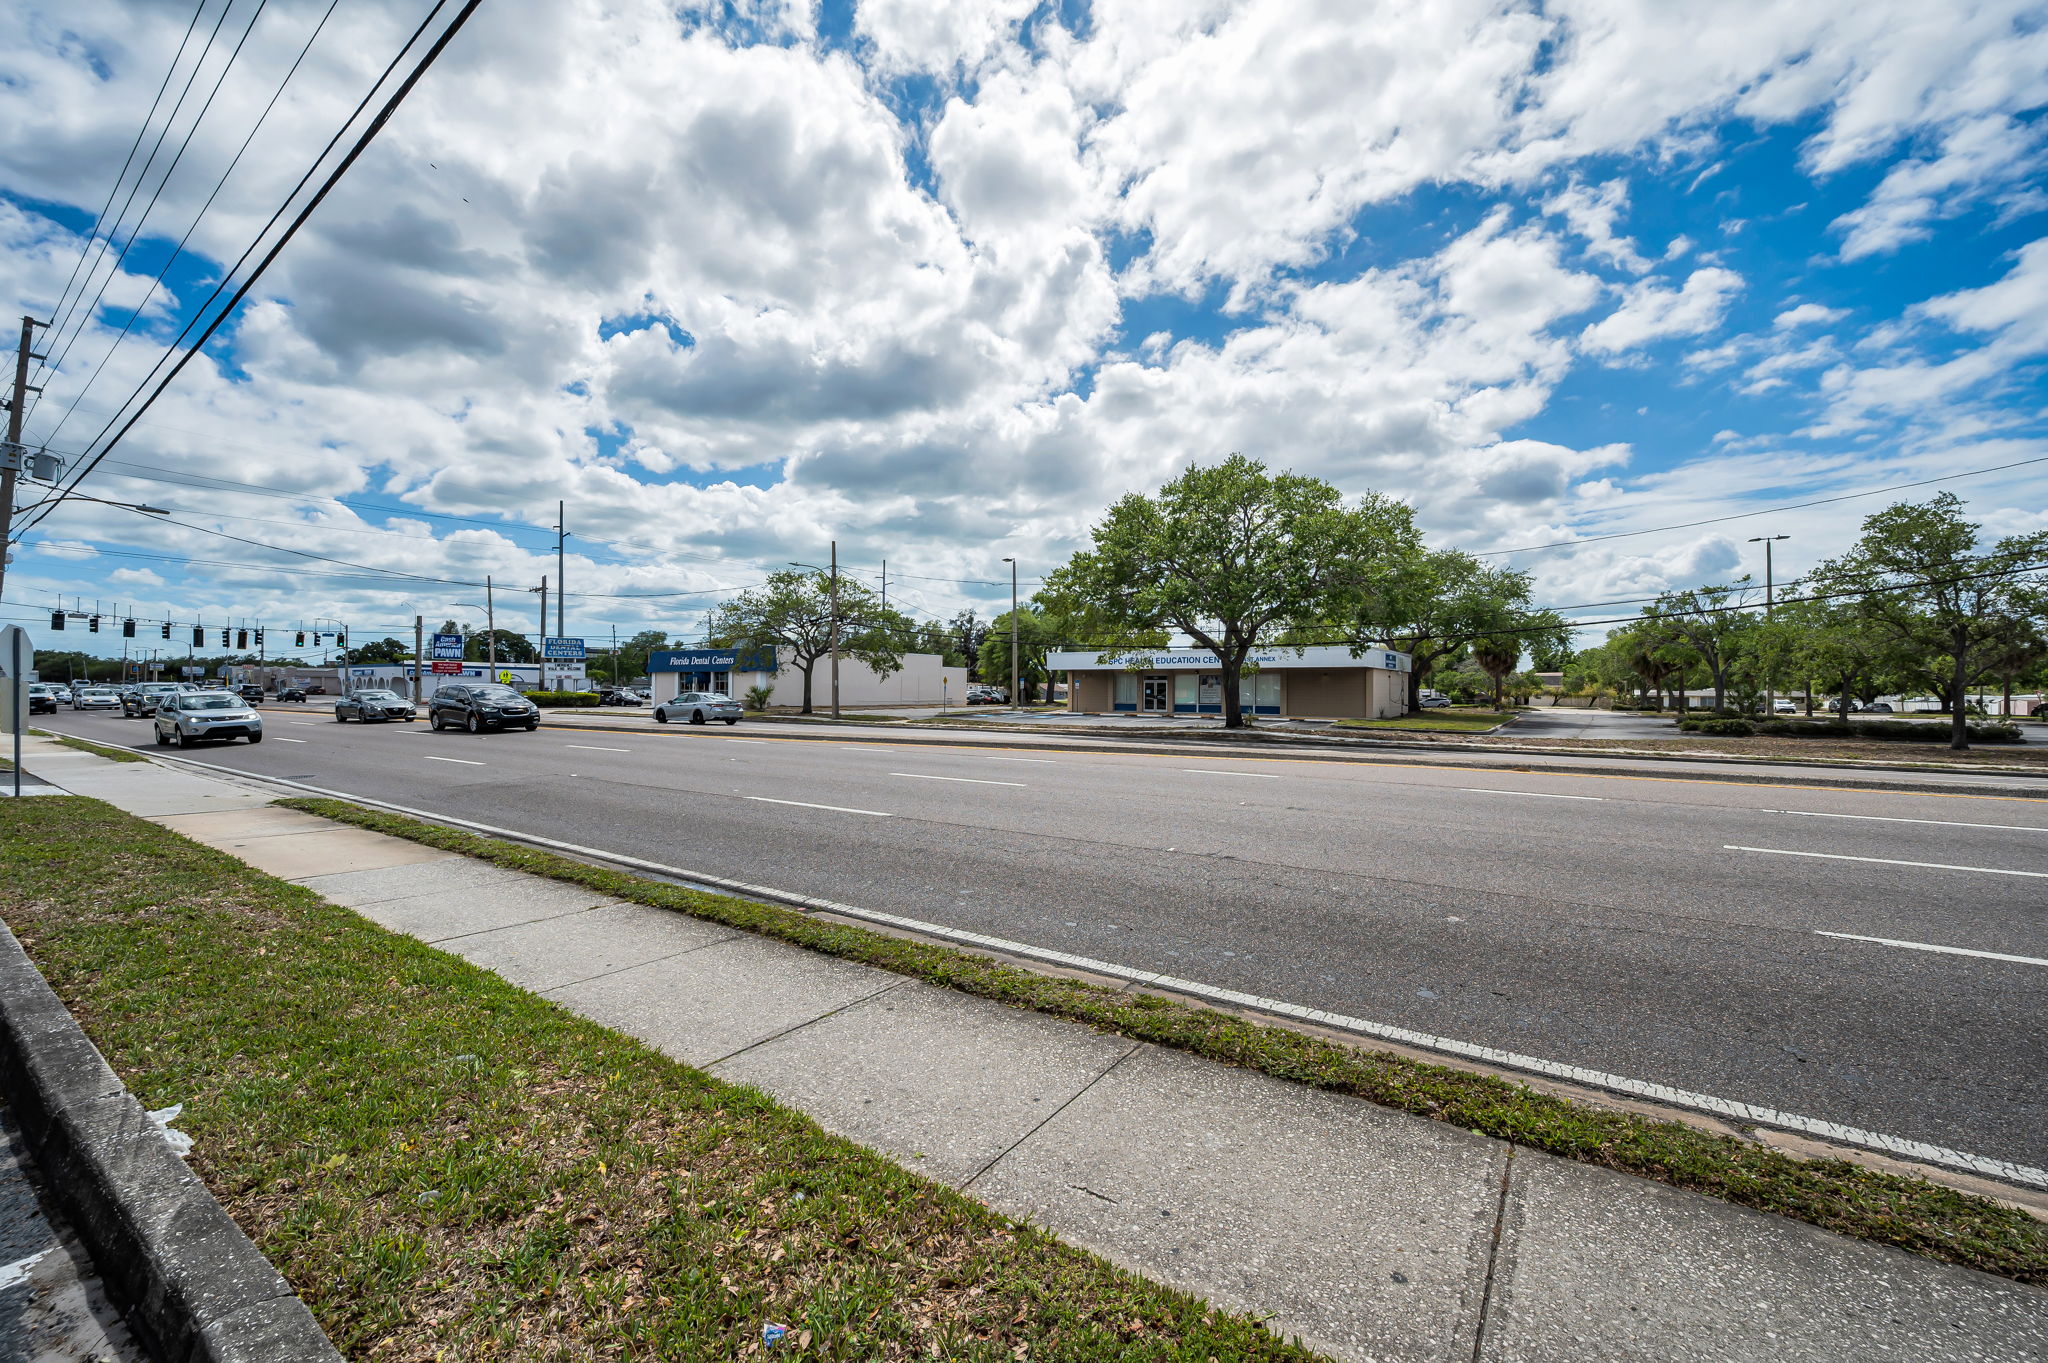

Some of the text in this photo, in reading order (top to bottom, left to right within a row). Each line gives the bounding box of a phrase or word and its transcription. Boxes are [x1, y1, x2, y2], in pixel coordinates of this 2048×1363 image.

[434, 647, 461, 658] PAWN
[669, 655, 734, 665] Florida Dental Centers
[1125, 656, 1154, 664] HEA
[1155, 656, 1201, 665] EDUCATION
